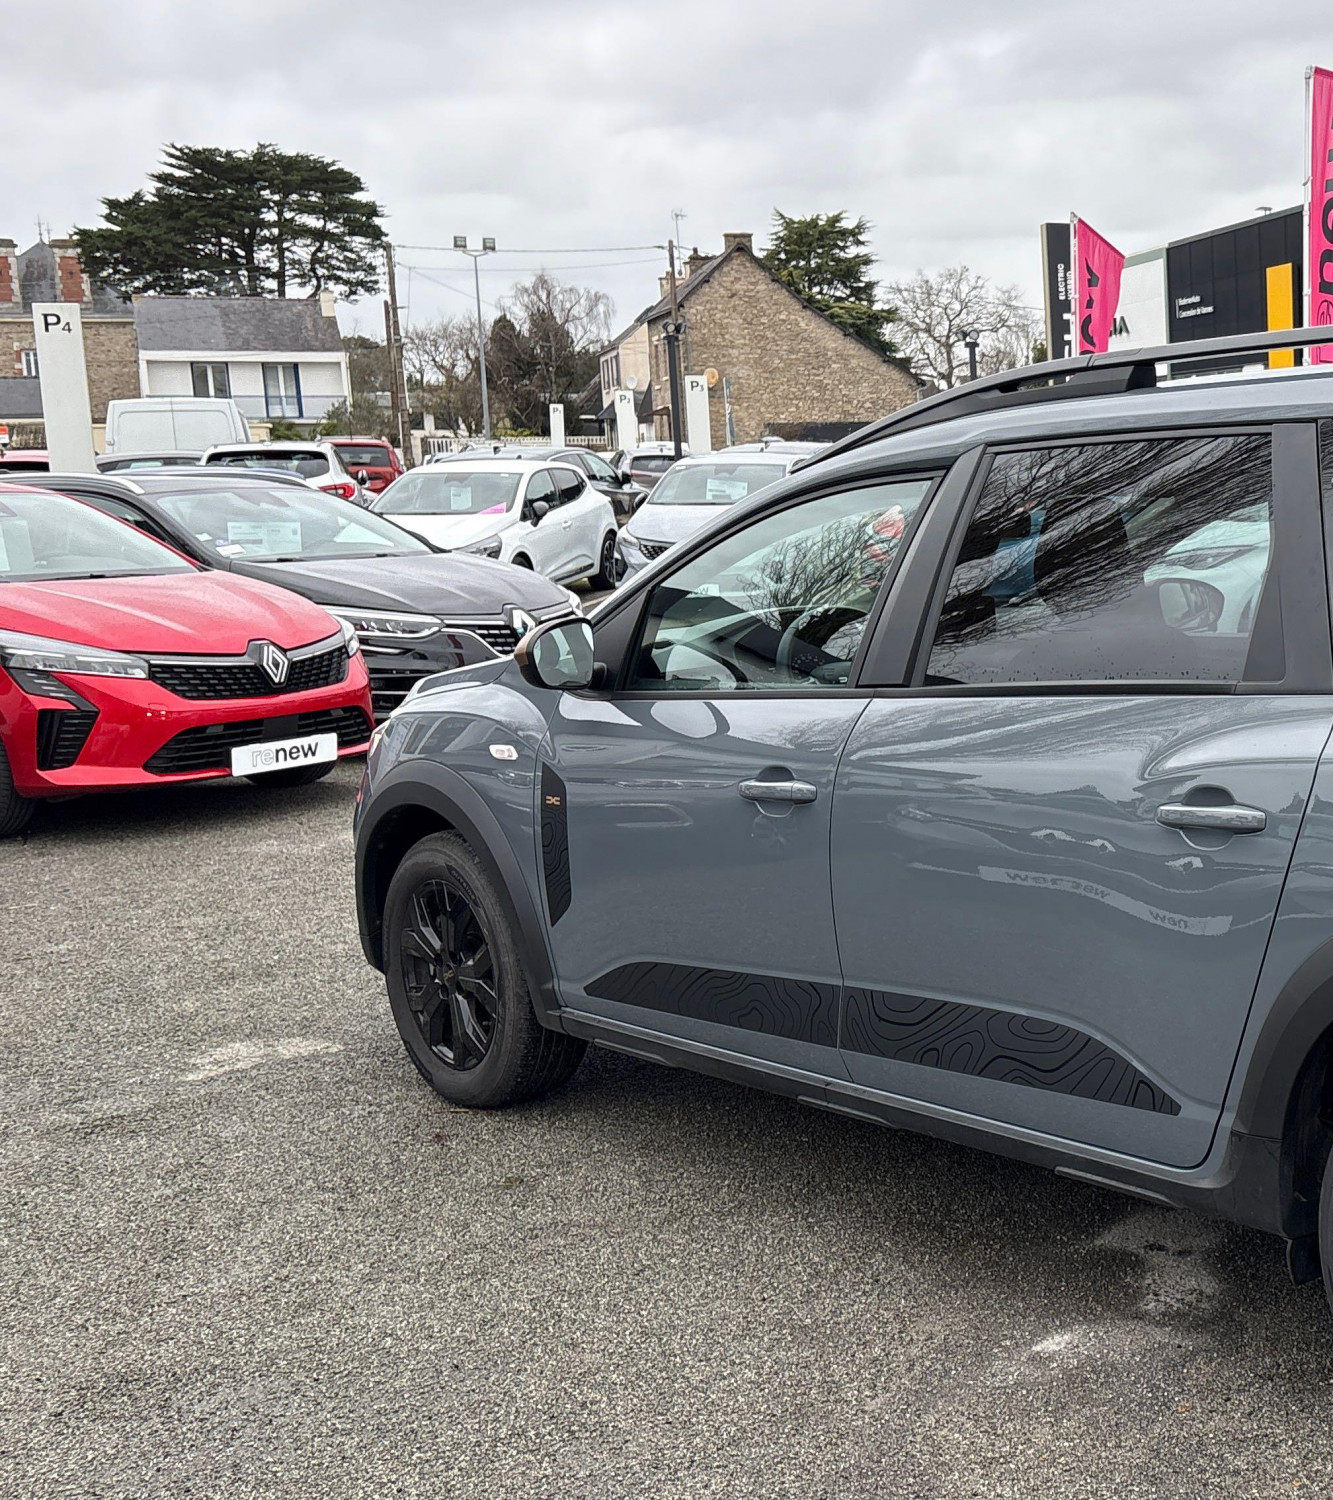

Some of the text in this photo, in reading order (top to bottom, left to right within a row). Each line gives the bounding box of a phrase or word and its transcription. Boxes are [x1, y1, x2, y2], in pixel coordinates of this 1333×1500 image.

[1057, 263, 1066, 300] ELECTRIC
[41, 313, 72, 334] P4
[251, 742, 318, 768] renew
